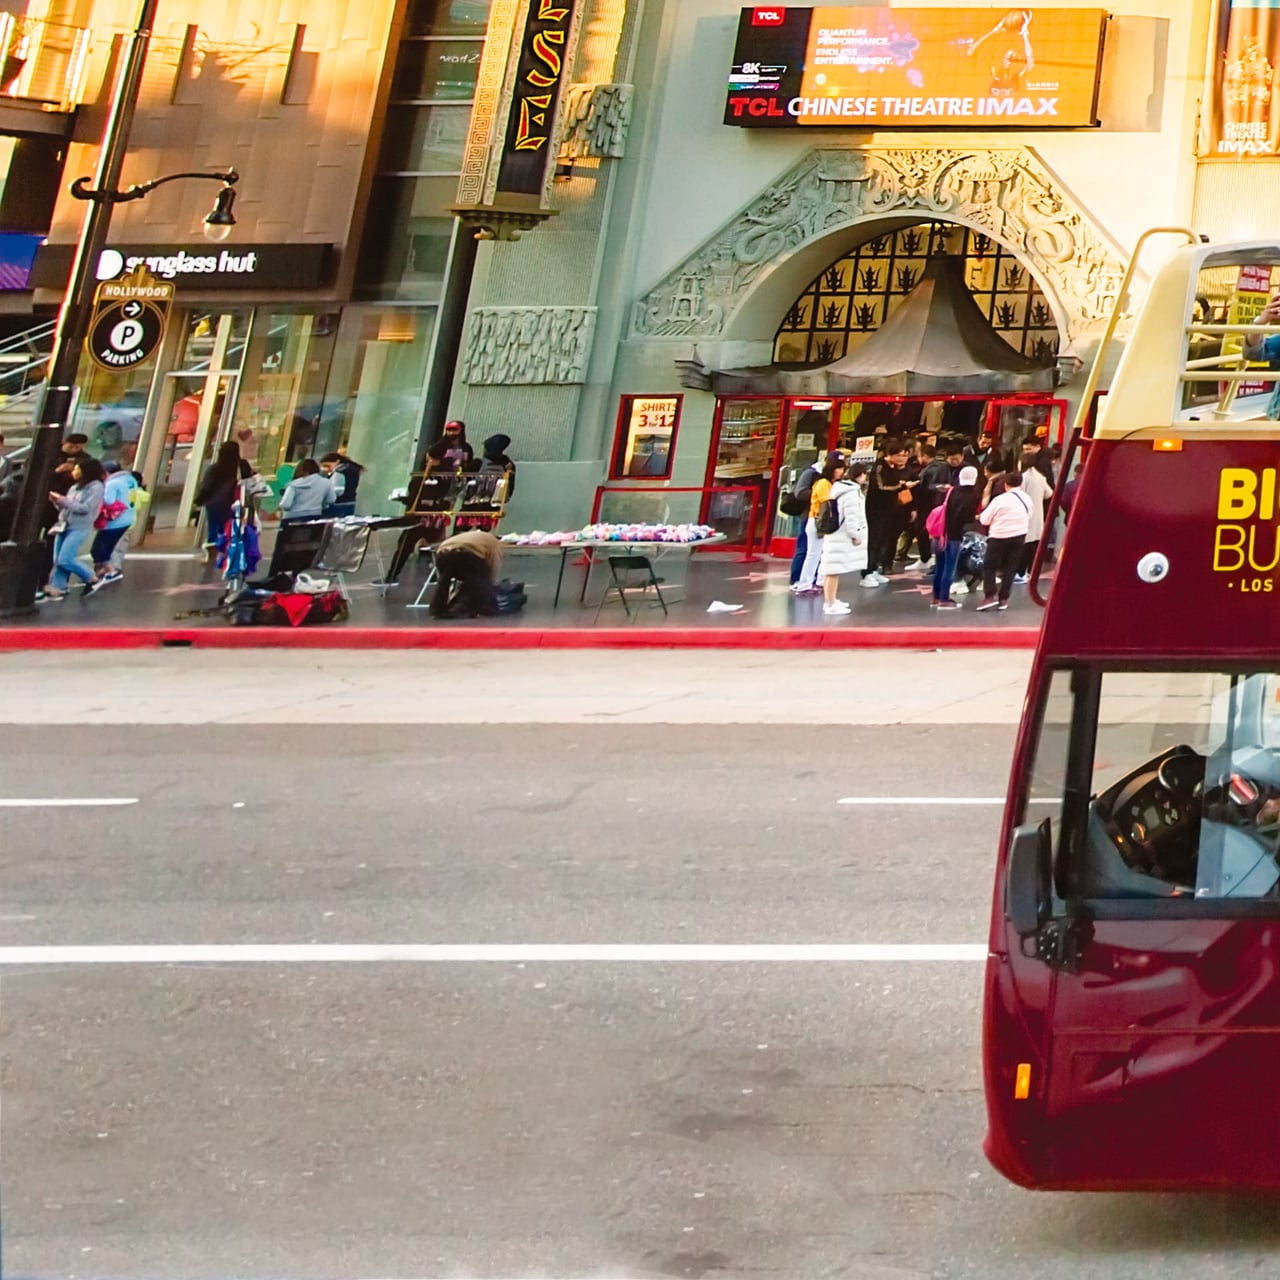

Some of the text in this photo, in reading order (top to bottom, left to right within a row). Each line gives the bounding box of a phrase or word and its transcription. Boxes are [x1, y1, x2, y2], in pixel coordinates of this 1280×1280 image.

[758, 12, 780, 20] TCL
[818, 28, 867, 37] QUANTUM
[817, 37, 891, 46] PERFORMANCE.
[816, 48, 858, 56] ENDLESS
[814, 57, 894, 65] ENTERTAINMENT.
[742, 63, 760, 73] 8K
[729, 97, 1058, 116] TCL CHINESE THEATRE IMAX
[1224, 122, 1267, 131] CHINESE
[1224, 130, 1267, 140] THEATRE
[1218, 140, 1272, 153] IMAX
[217, 250, 257, 272] hut
[105, 286, 169, 297] HOLLYWOOD
[120, 325, 136, 345] P
[101, 349, 144, 365] PARKING
[638, 414, 649, 427] 3
[1241, 578, 1274, 592] LOS
